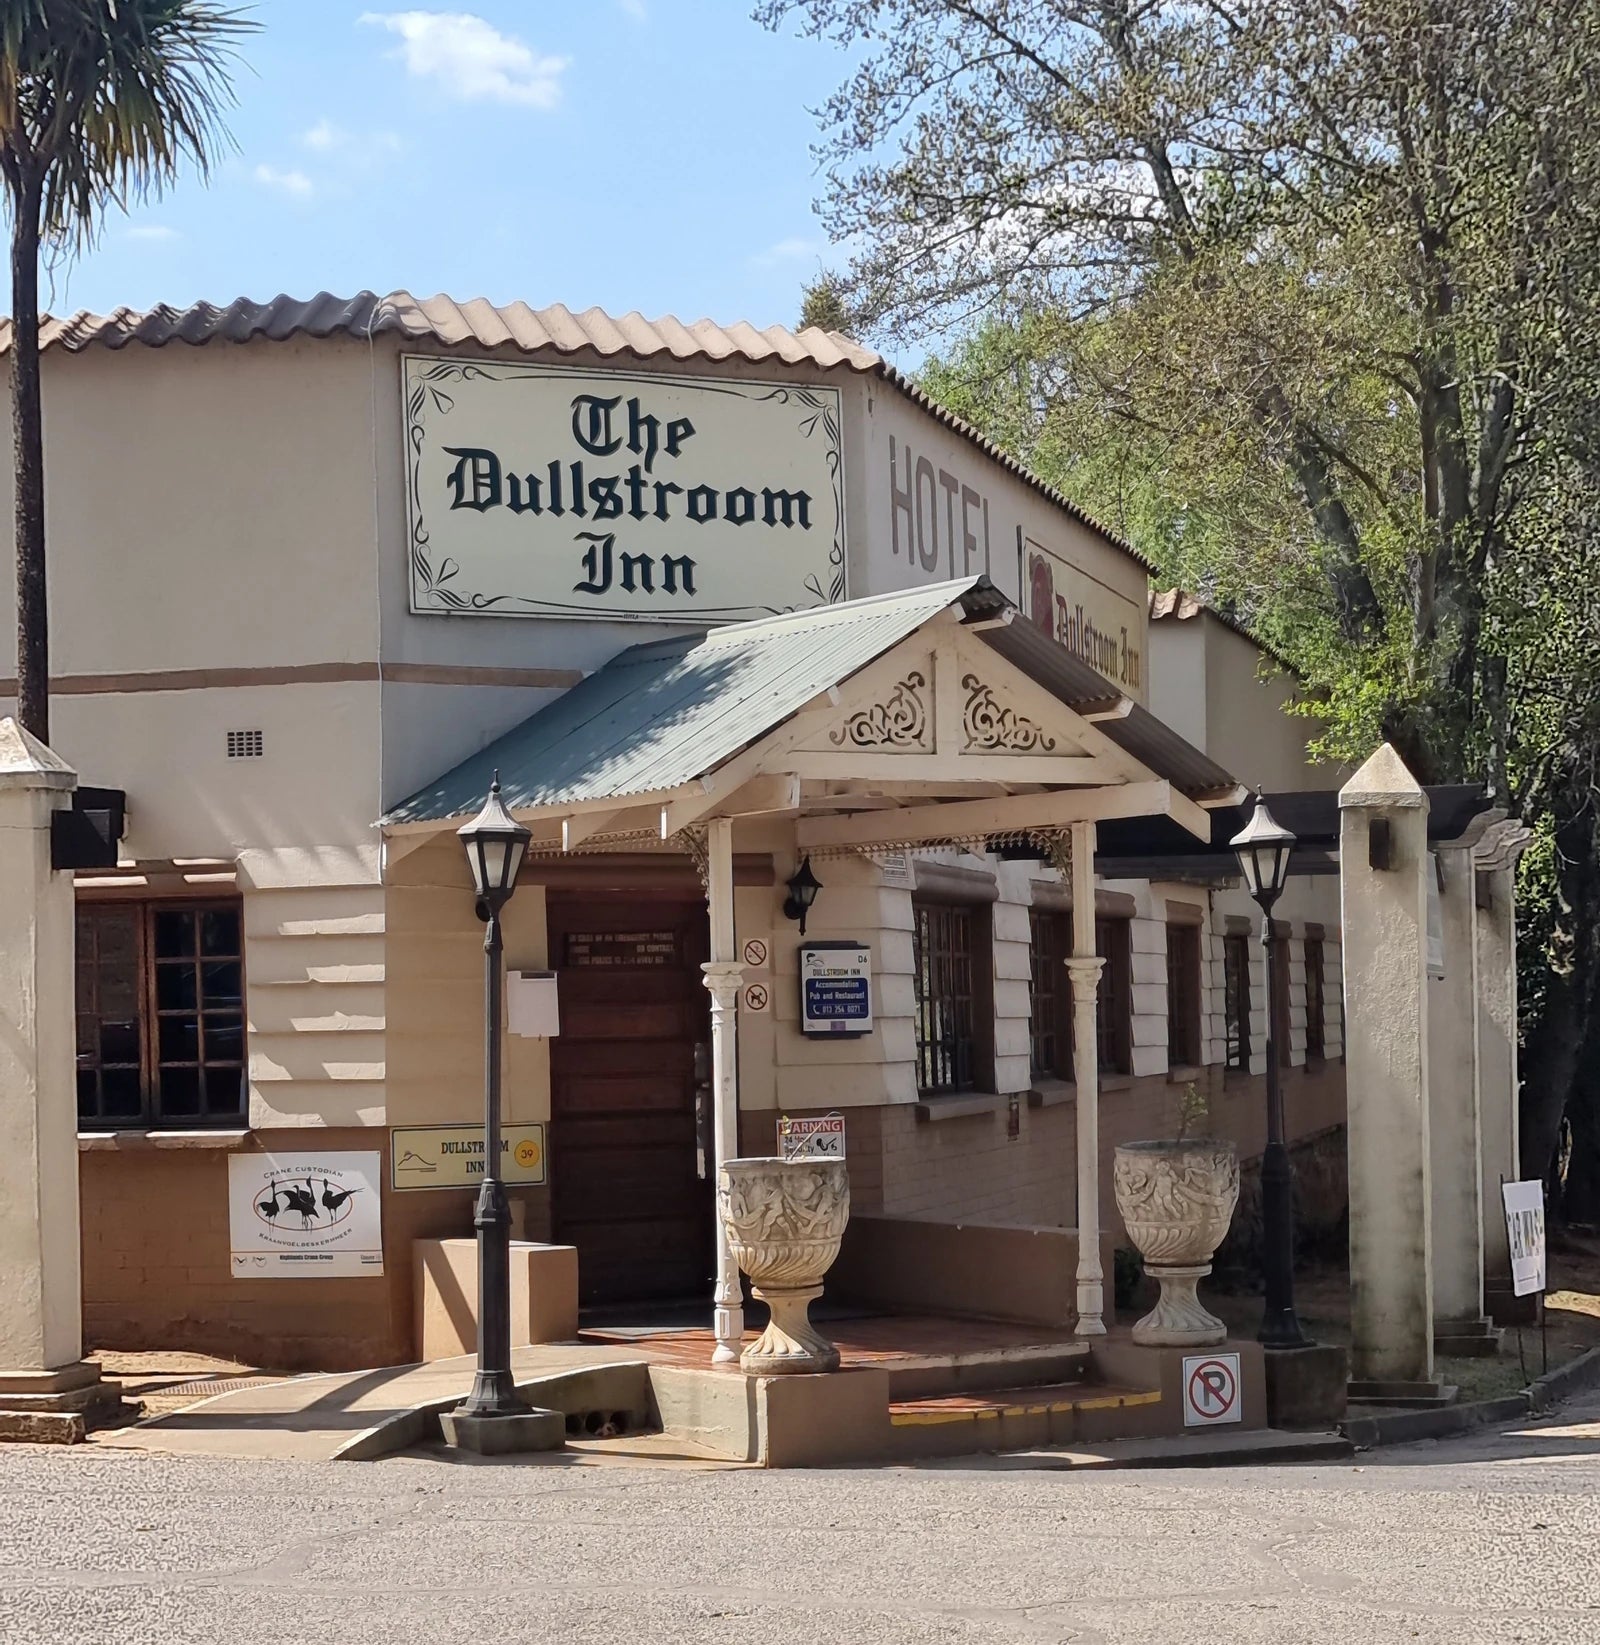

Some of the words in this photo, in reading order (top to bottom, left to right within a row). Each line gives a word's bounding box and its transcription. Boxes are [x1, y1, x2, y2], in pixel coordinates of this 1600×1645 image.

[570, 394, 696, 474] The
[441, 446, 813, 531] Dullstroom
[572, 531, 698, 597] Inn
[1120, 626, 1140, 689] Inn
[813, 968, 849, 976] DULLSTROOM
[850, 968, 861, 976] INN
[809, 992, 820, 1000] Pub
[822, 992, 833, 1000] and
[834, 991, 865, 1000] Restaurant
[441, 1140, 509, 1154] DULLSTRM
[521, 1149, 534, 1159] 39
[263, 1167, 292, 1179] CRANE
[295, 1166, 344, 1178] CUSTODIAN
[466, 1161, 485, 1173] INN
